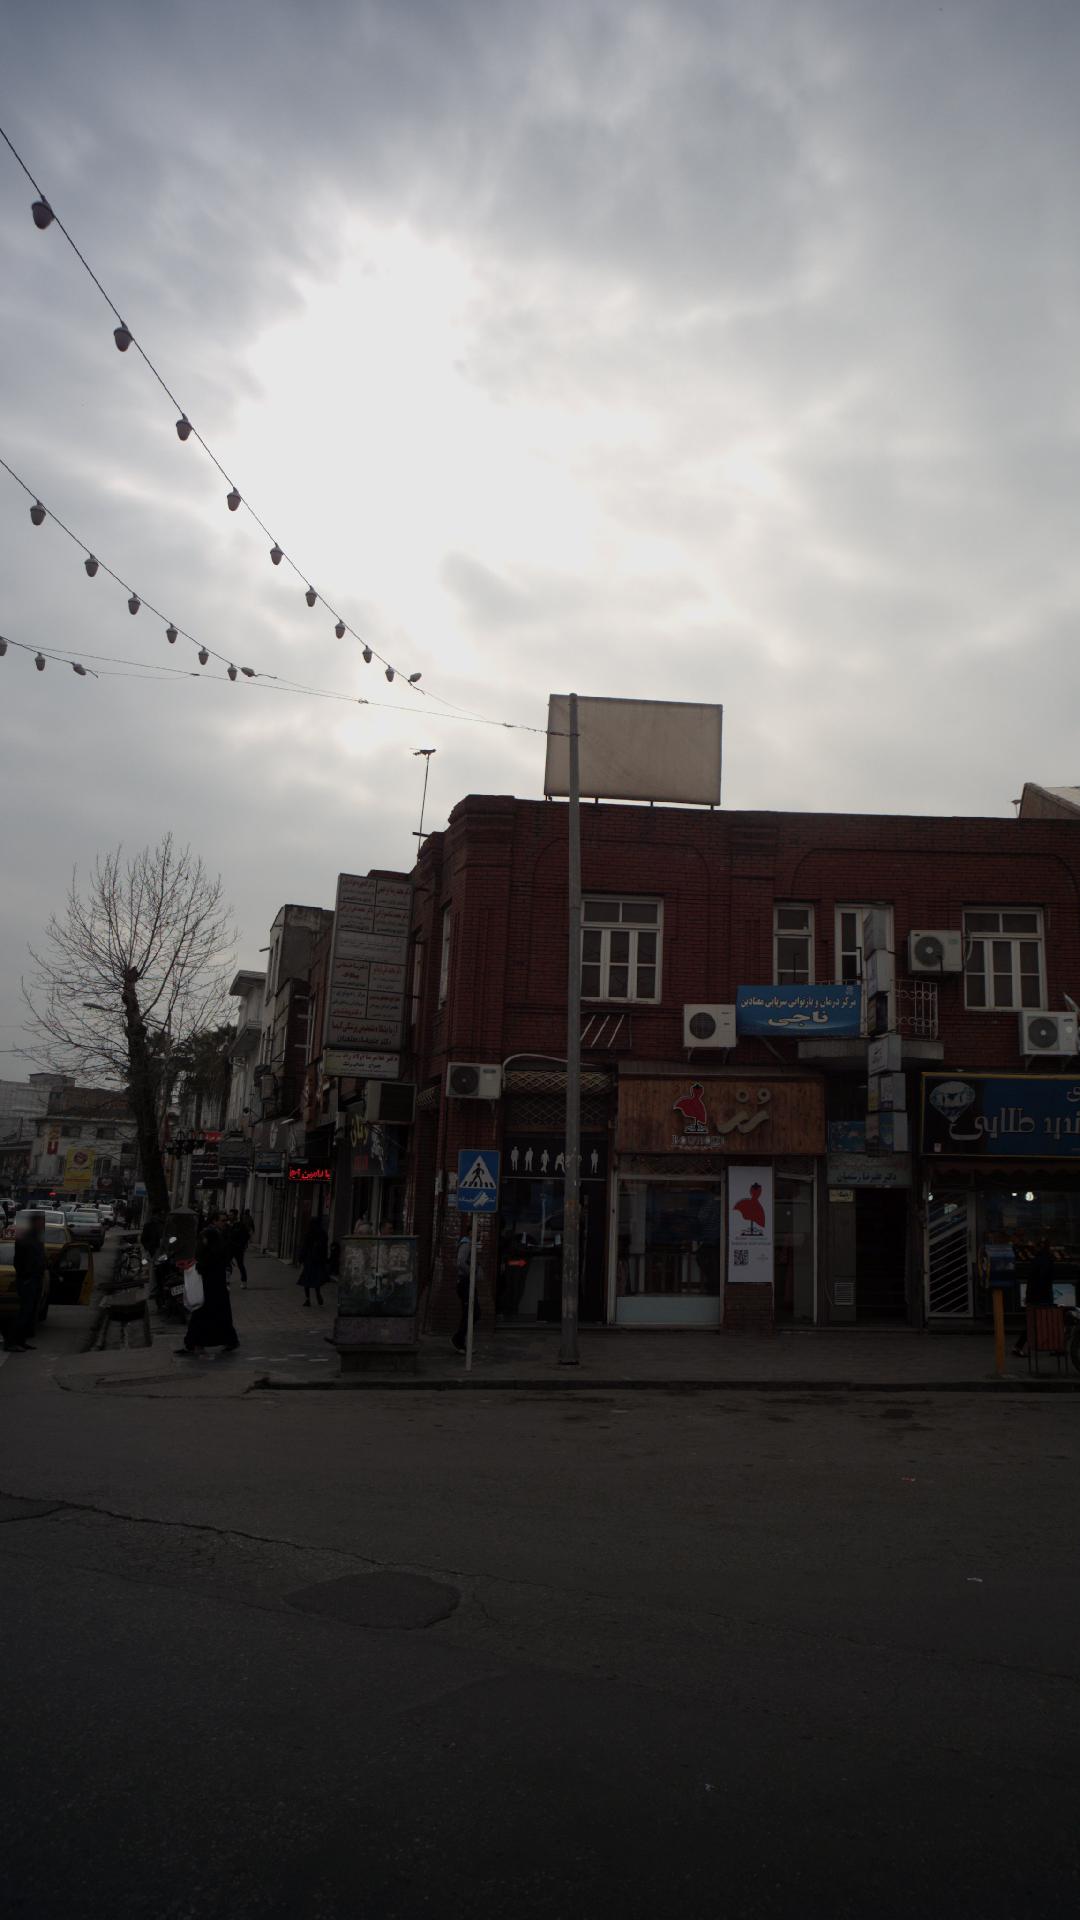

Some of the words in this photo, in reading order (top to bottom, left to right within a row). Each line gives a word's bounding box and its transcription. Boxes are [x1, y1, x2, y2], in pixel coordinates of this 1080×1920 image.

[740, 996, 764, 1009] معتادین
[820, 996, 840, 1009] درمان
[840, 996, 857, 1009] مرکز
[767, 1010, 830, 1027] ناجی
